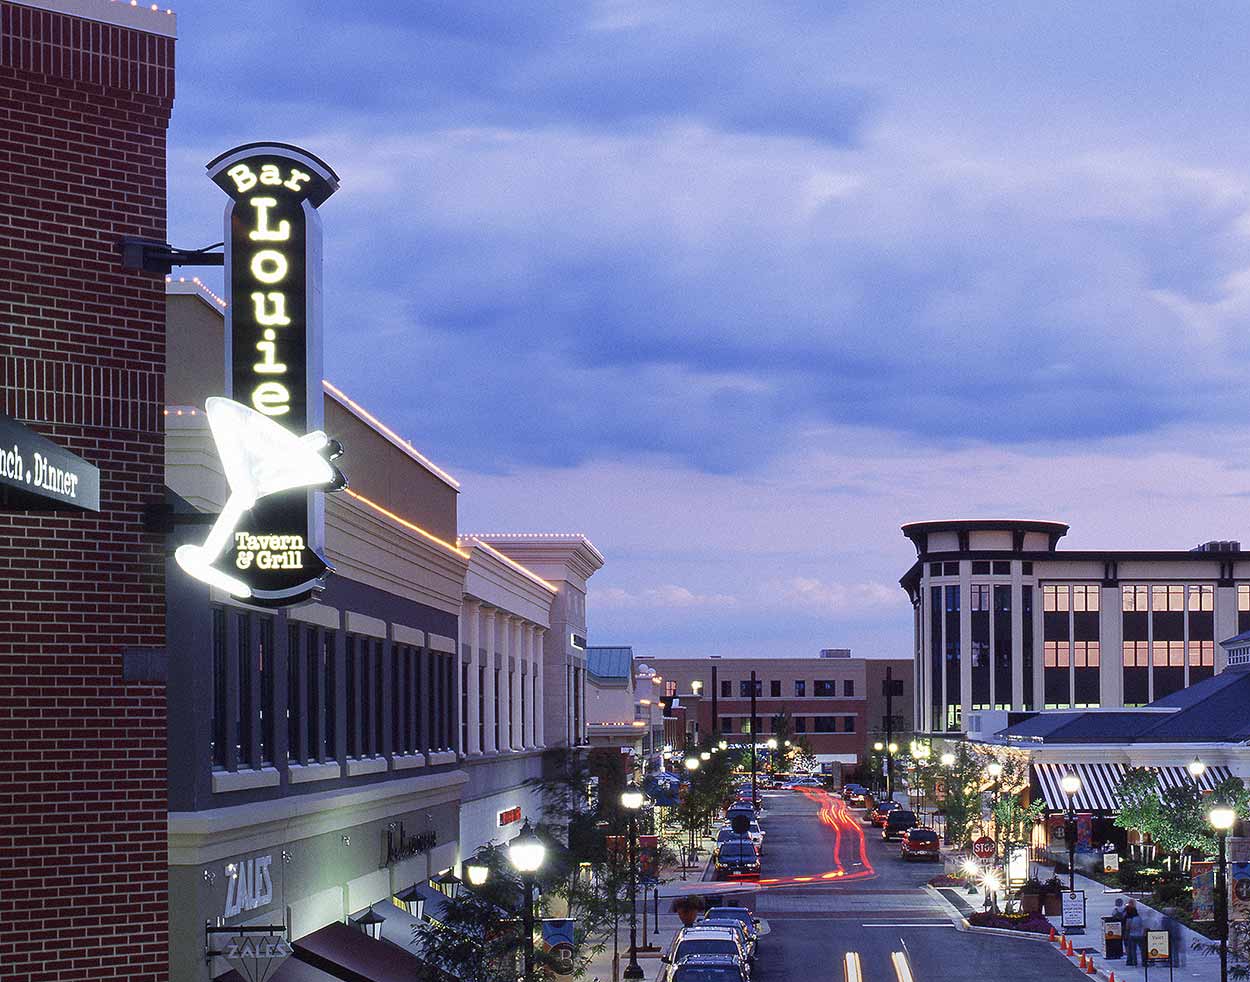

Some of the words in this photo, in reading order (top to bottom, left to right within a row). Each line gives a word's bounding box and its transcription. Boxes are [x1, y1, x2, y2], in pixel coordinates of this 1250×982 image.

[227, 163, 310, 193] Bar
[248, 197, 291, 416] Louie
[34, 452, 79, 498] Dinner
[235, 532, 305, 550] Tavern
[236, 551, 254, 569] &
[256, 551, 303, 569] Grill
[226, 944, 292, 959] ZALES
